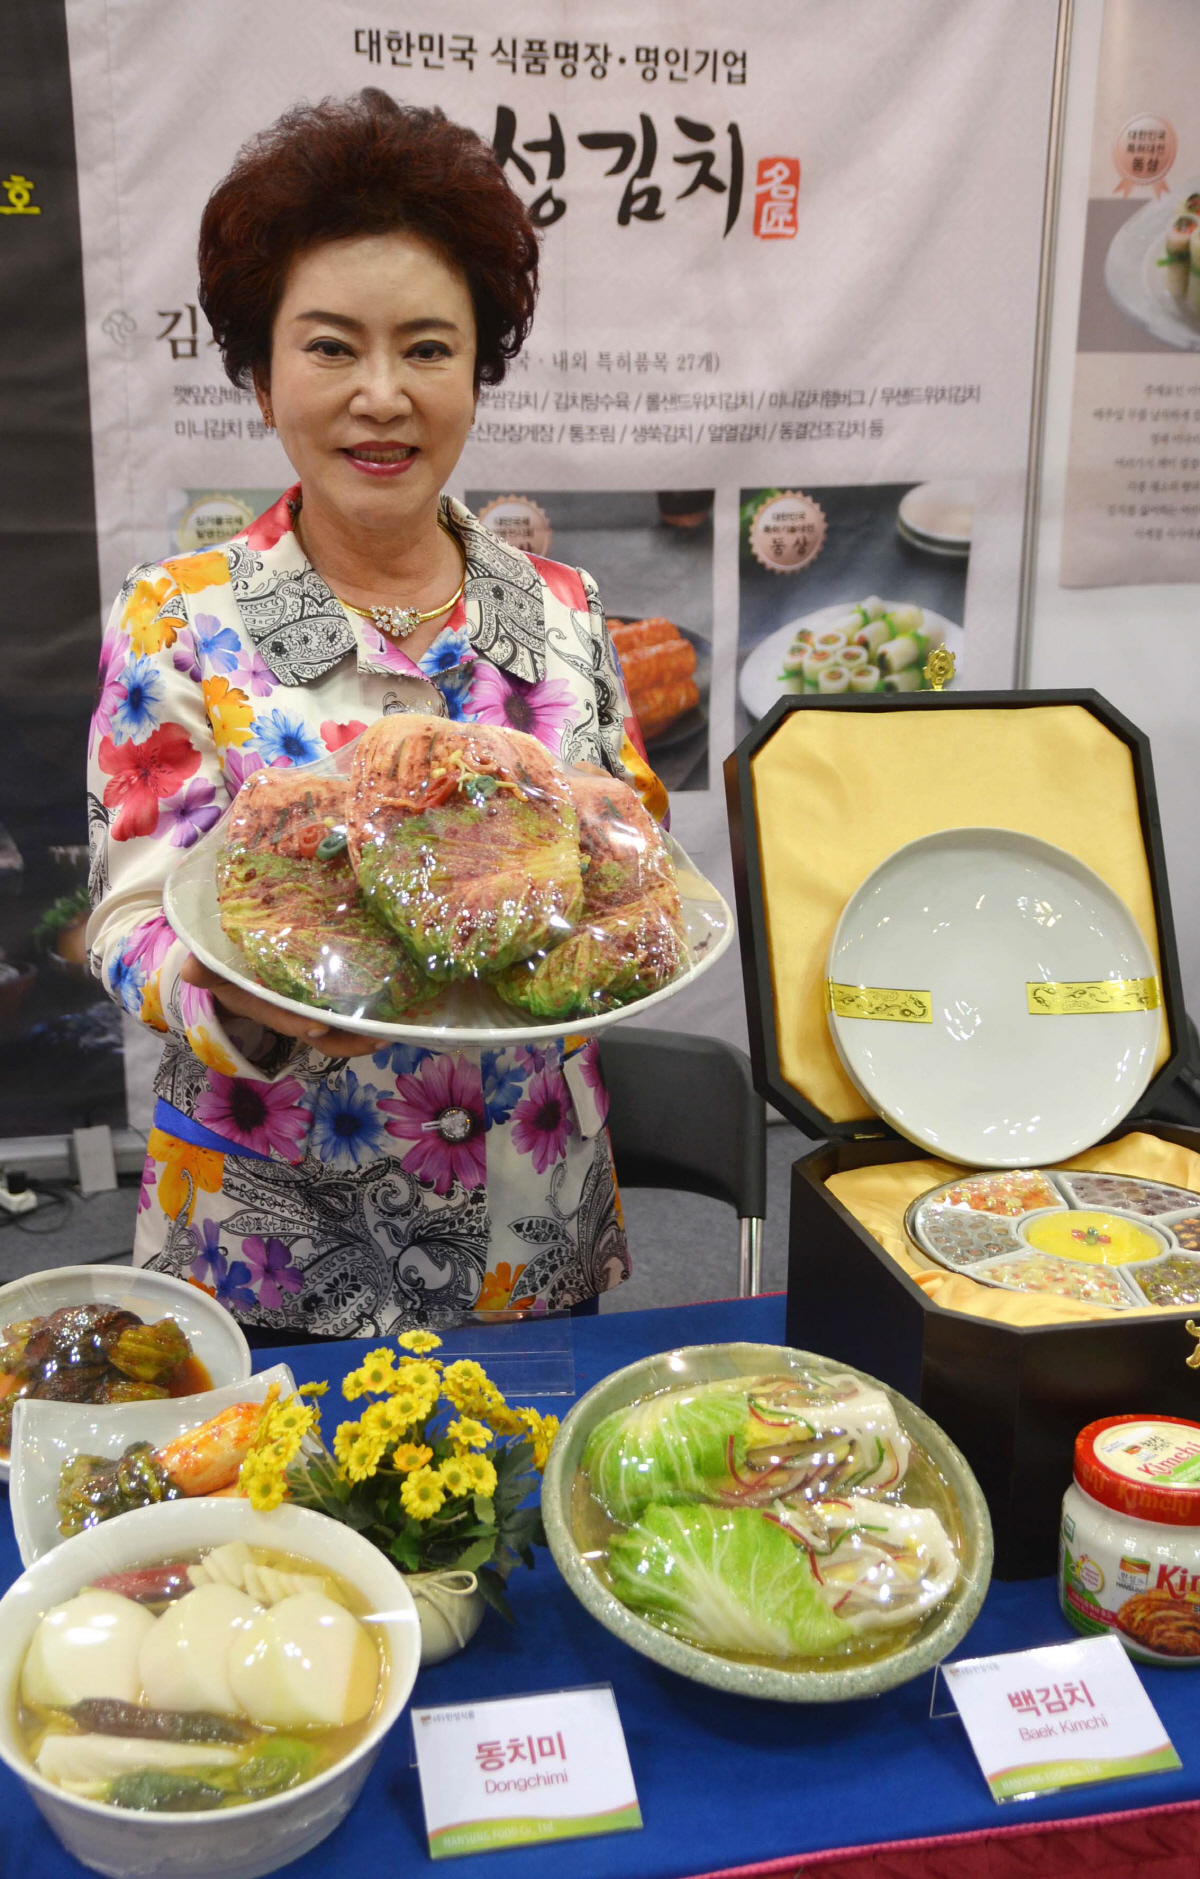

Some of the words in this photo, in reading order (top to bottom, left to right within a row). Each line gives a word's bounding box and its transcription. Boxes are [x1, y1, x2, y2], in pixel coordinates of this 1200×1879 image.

[354, 28, 478, 72] 대한민국
[0, 174, 41, 215] 호
[597, 351, 668, 374] 특허품목
[174, 418, 242, 439] 미니김치
[1007, 1680, 1096, 1718] 백김치
[1018, 1723, 1058, 1742] Baek
[1060, 1713, 1109, 1736] Kimchi
[475, 1731, 568, 1773] 동치미
[484, 1768, 569, 1796] Dongchimi
